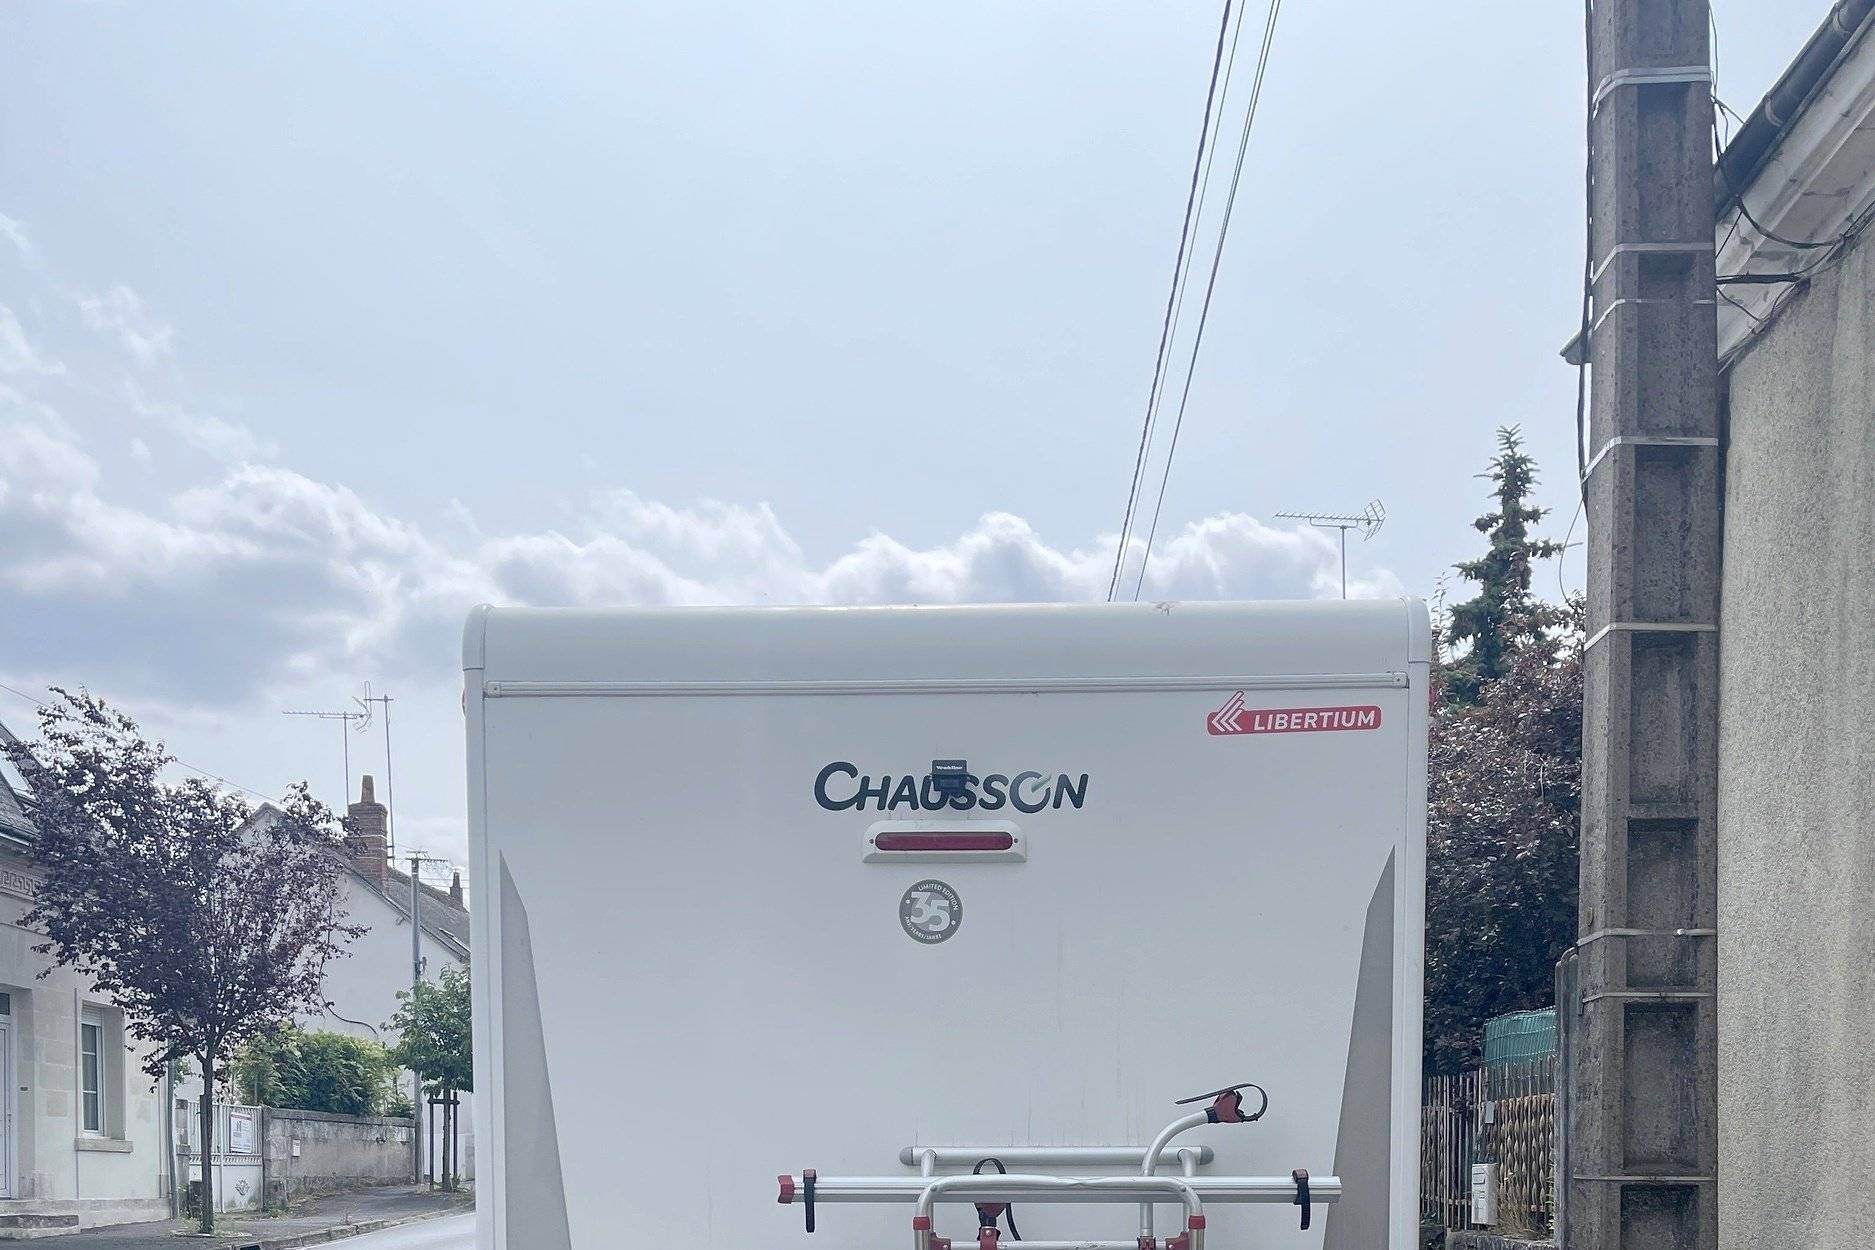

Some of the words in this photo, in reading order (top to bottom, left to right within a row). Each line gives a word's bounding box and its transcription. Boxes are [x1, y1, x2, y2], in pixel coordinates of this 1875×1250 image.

[1253, 710, 1376, 731] LIBERTIUM
[813, 761, 1089, 814] CHAUSSON
[910, 891, 950, 932] 35
[918, 883, 942, 891] LIMITED
[942, 887, 960, 911] EDITION
